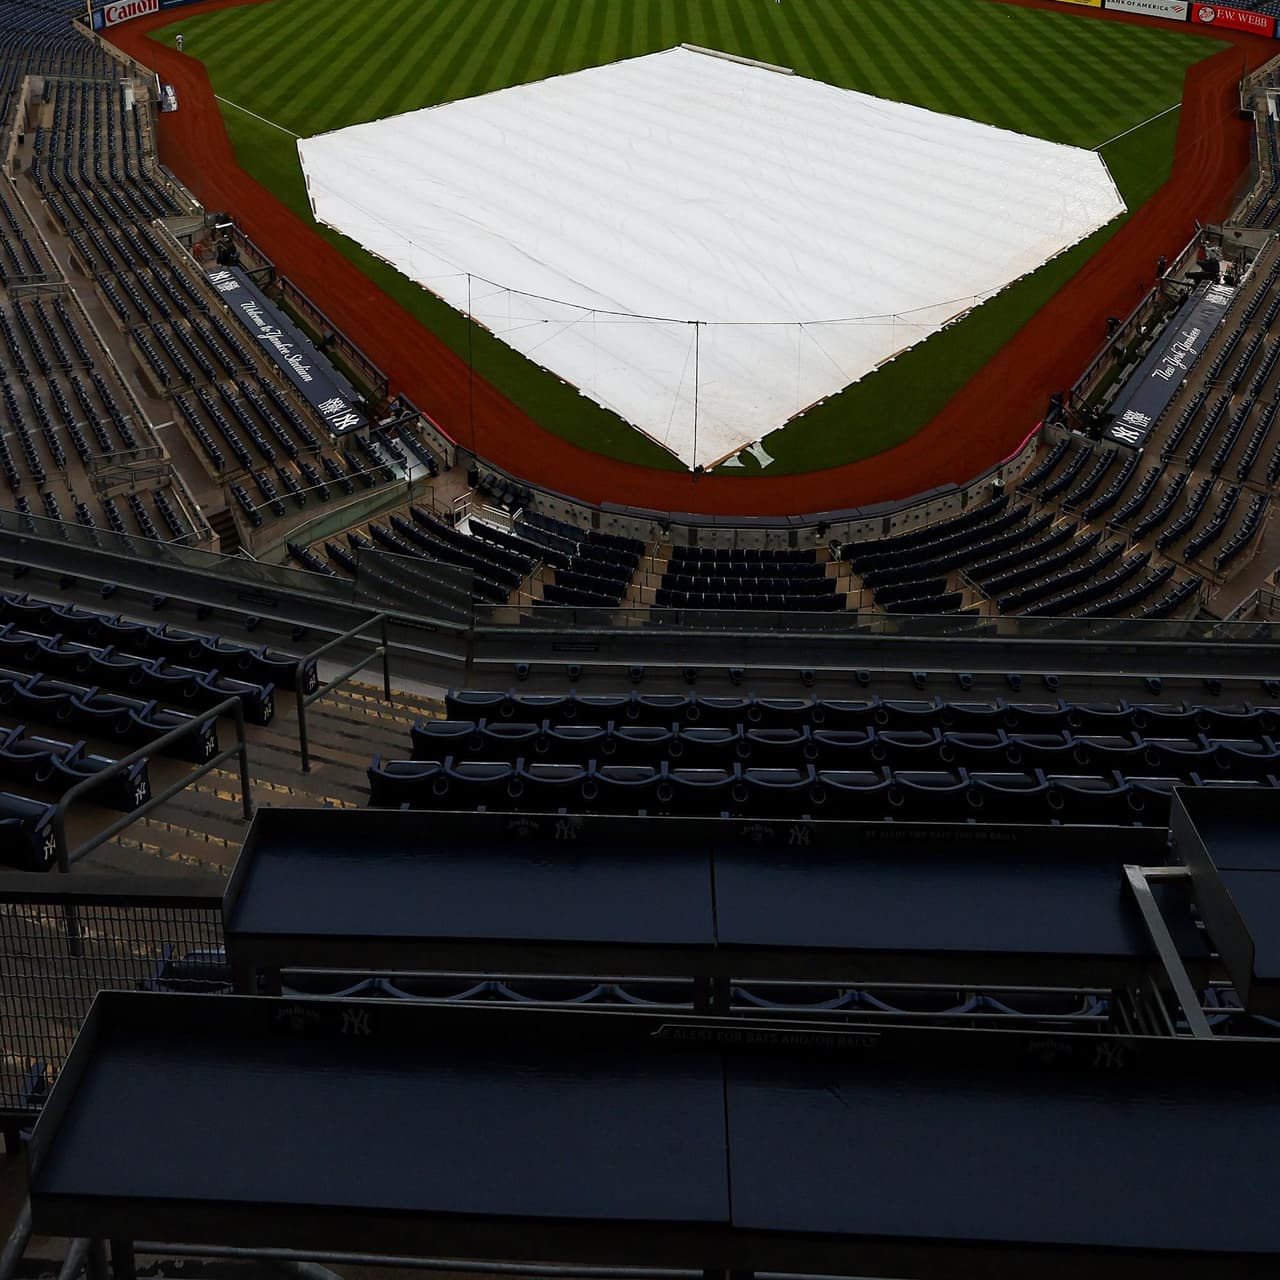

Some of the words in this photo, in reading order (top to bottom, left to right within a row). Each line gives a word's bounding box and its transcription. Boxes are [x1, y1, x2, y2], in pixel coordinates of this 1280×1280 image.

[1137, 2, 1169, 12] AMERICA
[1238, 13, 1268, 28] WEBB
[240, 300, 266, 327] Welcome
[257, 328, 293, 356] Yankee
[284, 353, 313, 383] Stadium
[1171, 327, 1202, 355] Yankees
[1163, 350, 1188, 370] York
[1152, 364, 1176, 382] New
[332, 413, 360, 431] NY
[1111, 426, 1141, 445] NY
